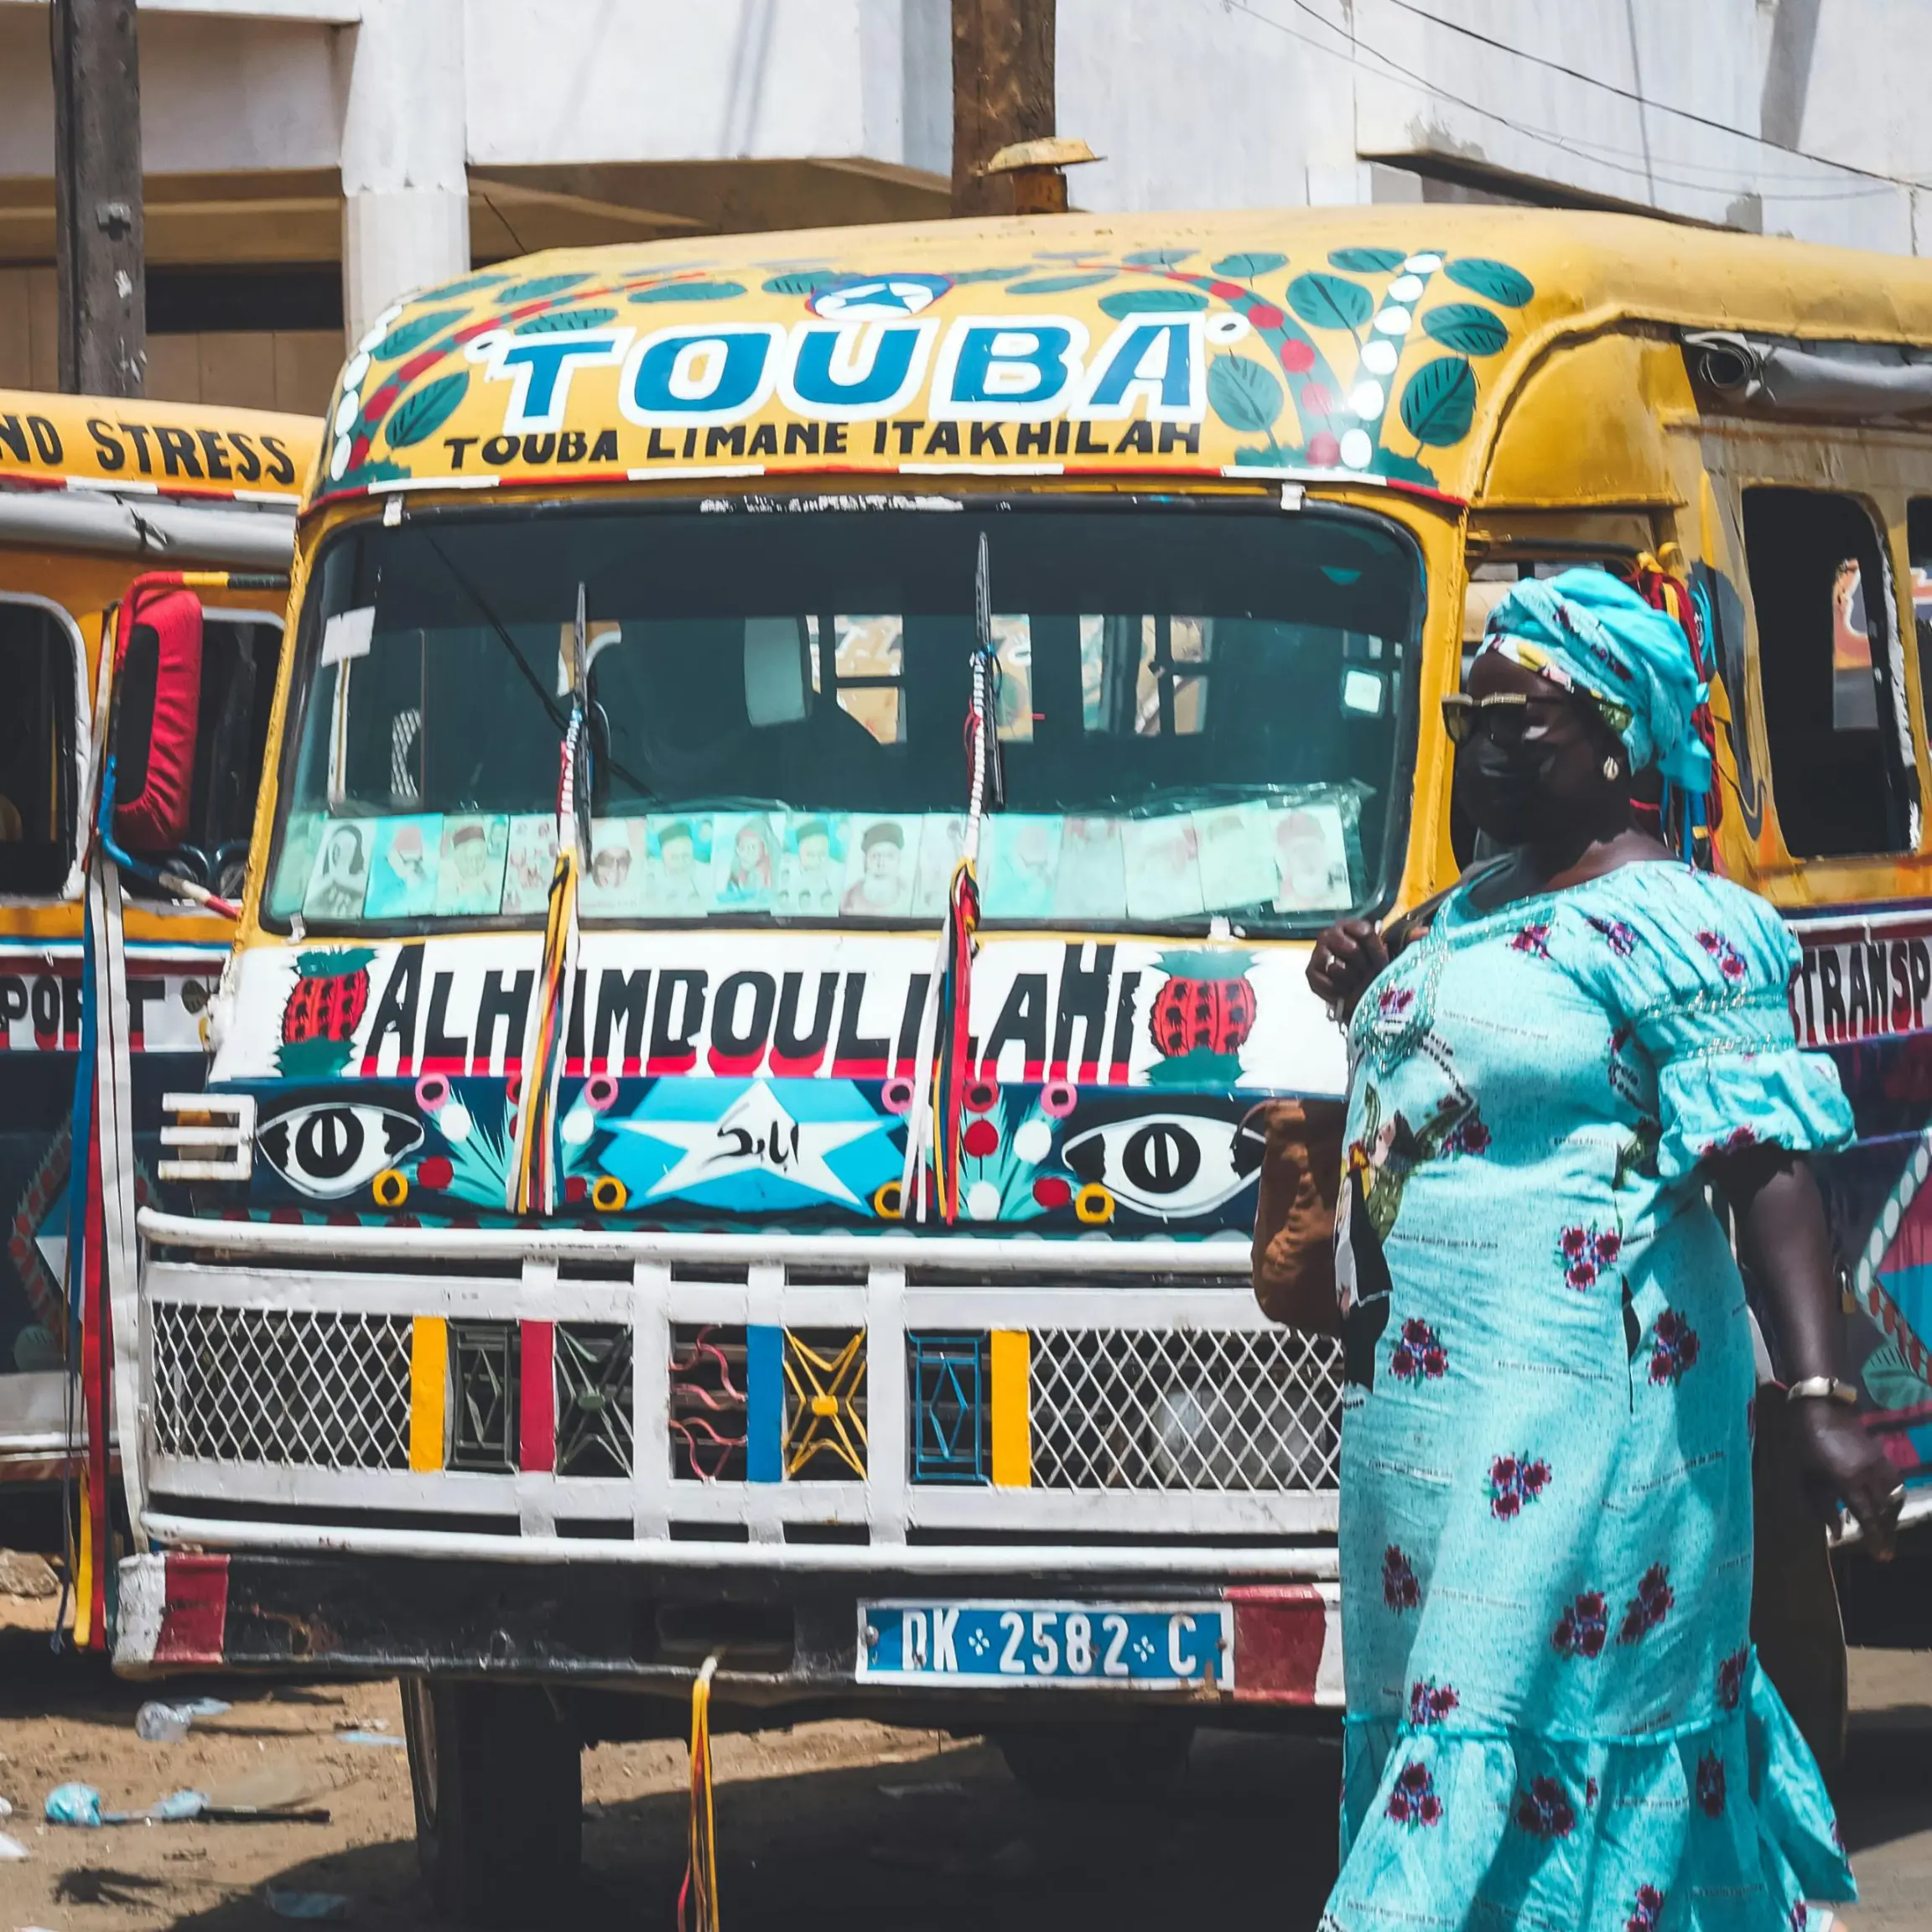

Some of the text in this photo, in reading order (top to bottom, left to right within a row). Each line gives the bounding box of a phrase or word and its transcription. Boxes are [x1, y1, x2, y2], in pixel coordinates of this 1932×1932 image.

[496, 311, 1206, 434] TOUBA
[0, 414, 296, 485] ND STRESS
[444, 421, 1202, 470] TOUBA LIMANE ITAKHILAH
[1801, 939, 1932, 1047] TRANSP
[901, 1607, 1197, 1676] DK 2582 C
